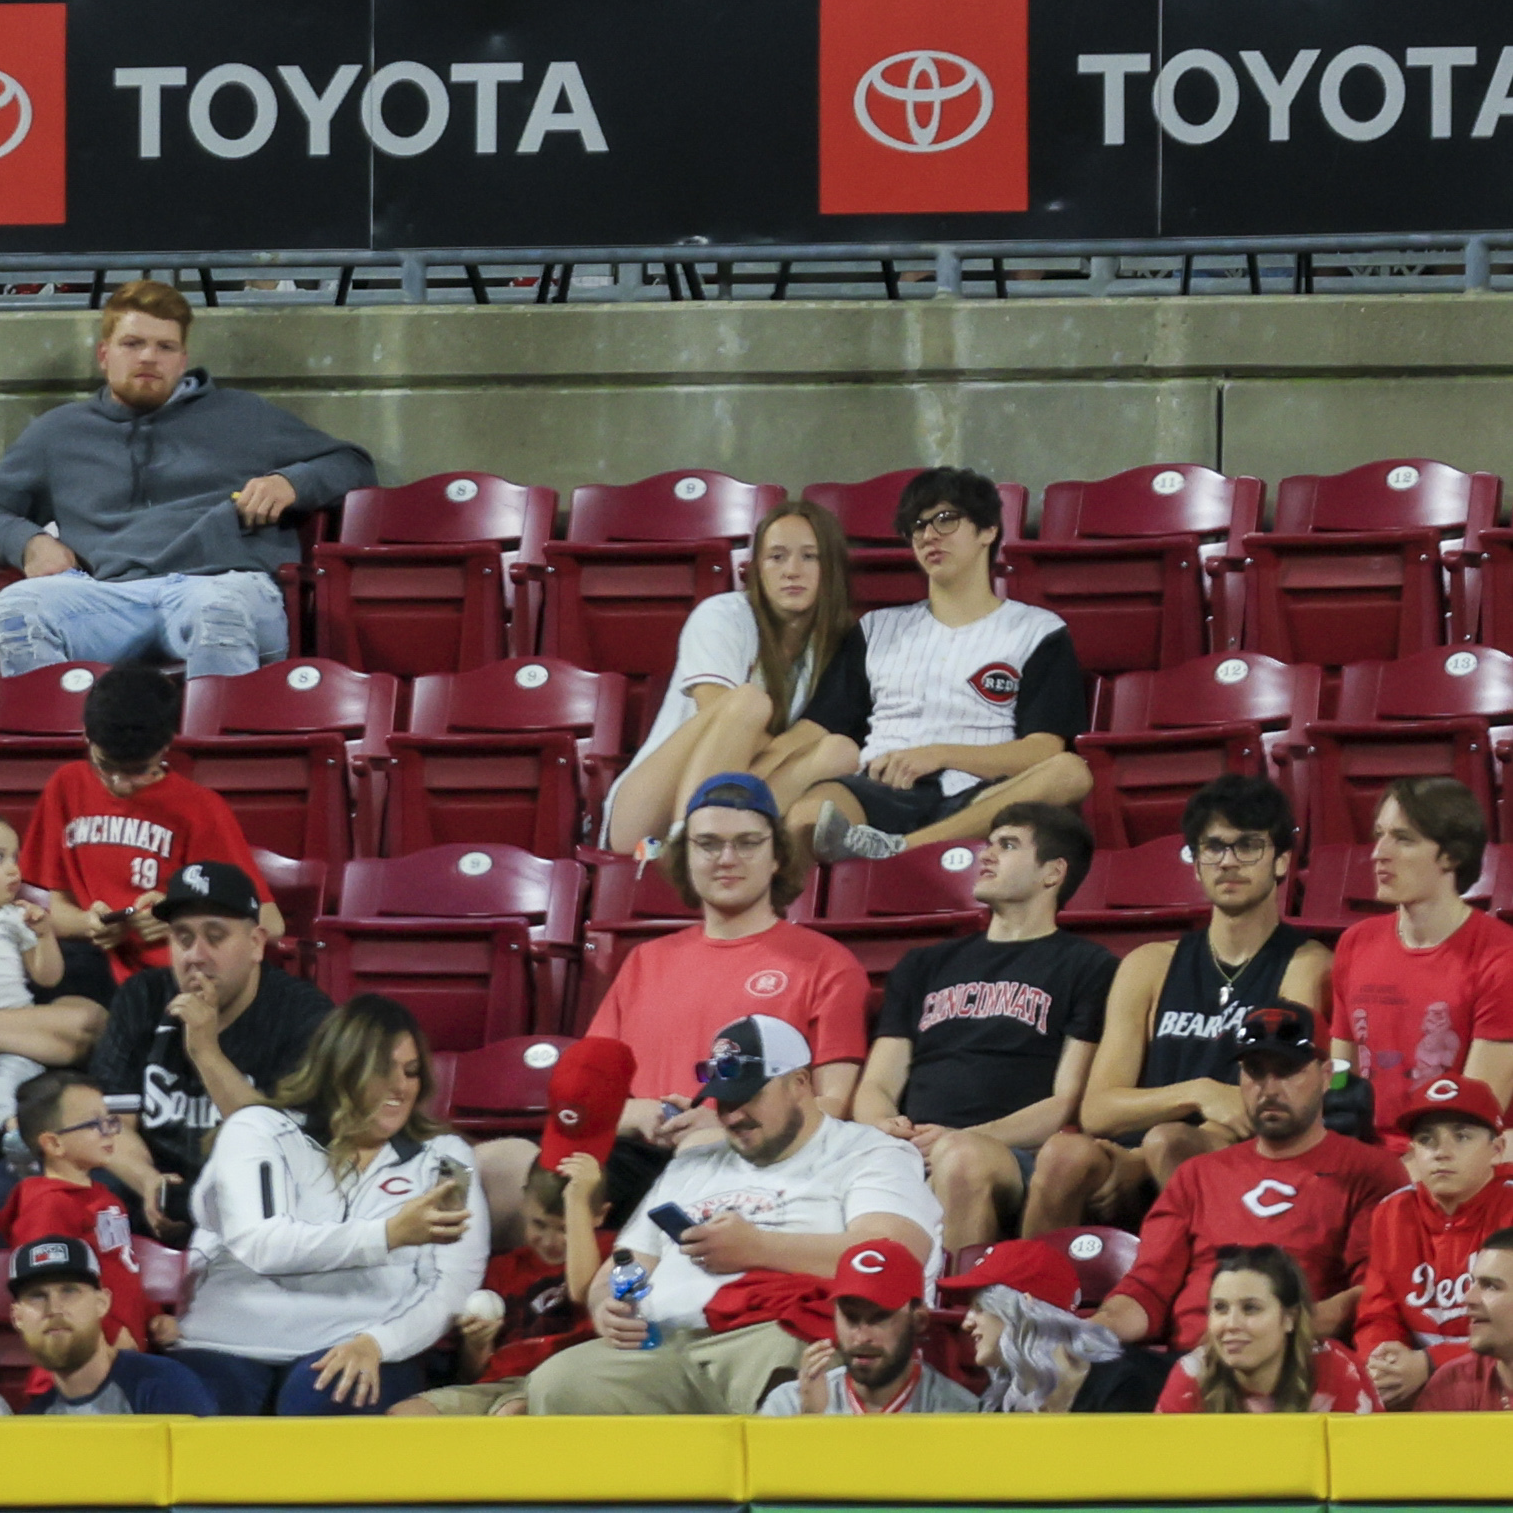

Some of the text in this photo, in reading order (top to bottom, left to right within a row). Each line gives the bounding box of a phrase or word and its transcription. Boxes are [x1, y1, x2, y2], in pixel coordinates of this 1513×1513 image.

[113, 60, 608, 160] TOYOTA
[984, 677, 1020, 692] RED
[65, 816, 174, 859] CINCINNATI
[129, 857, 158, 890] 19
[918, 980, 1054, 1036] CINCINNATI
[1077, 1240, 1095, 1253] 13
